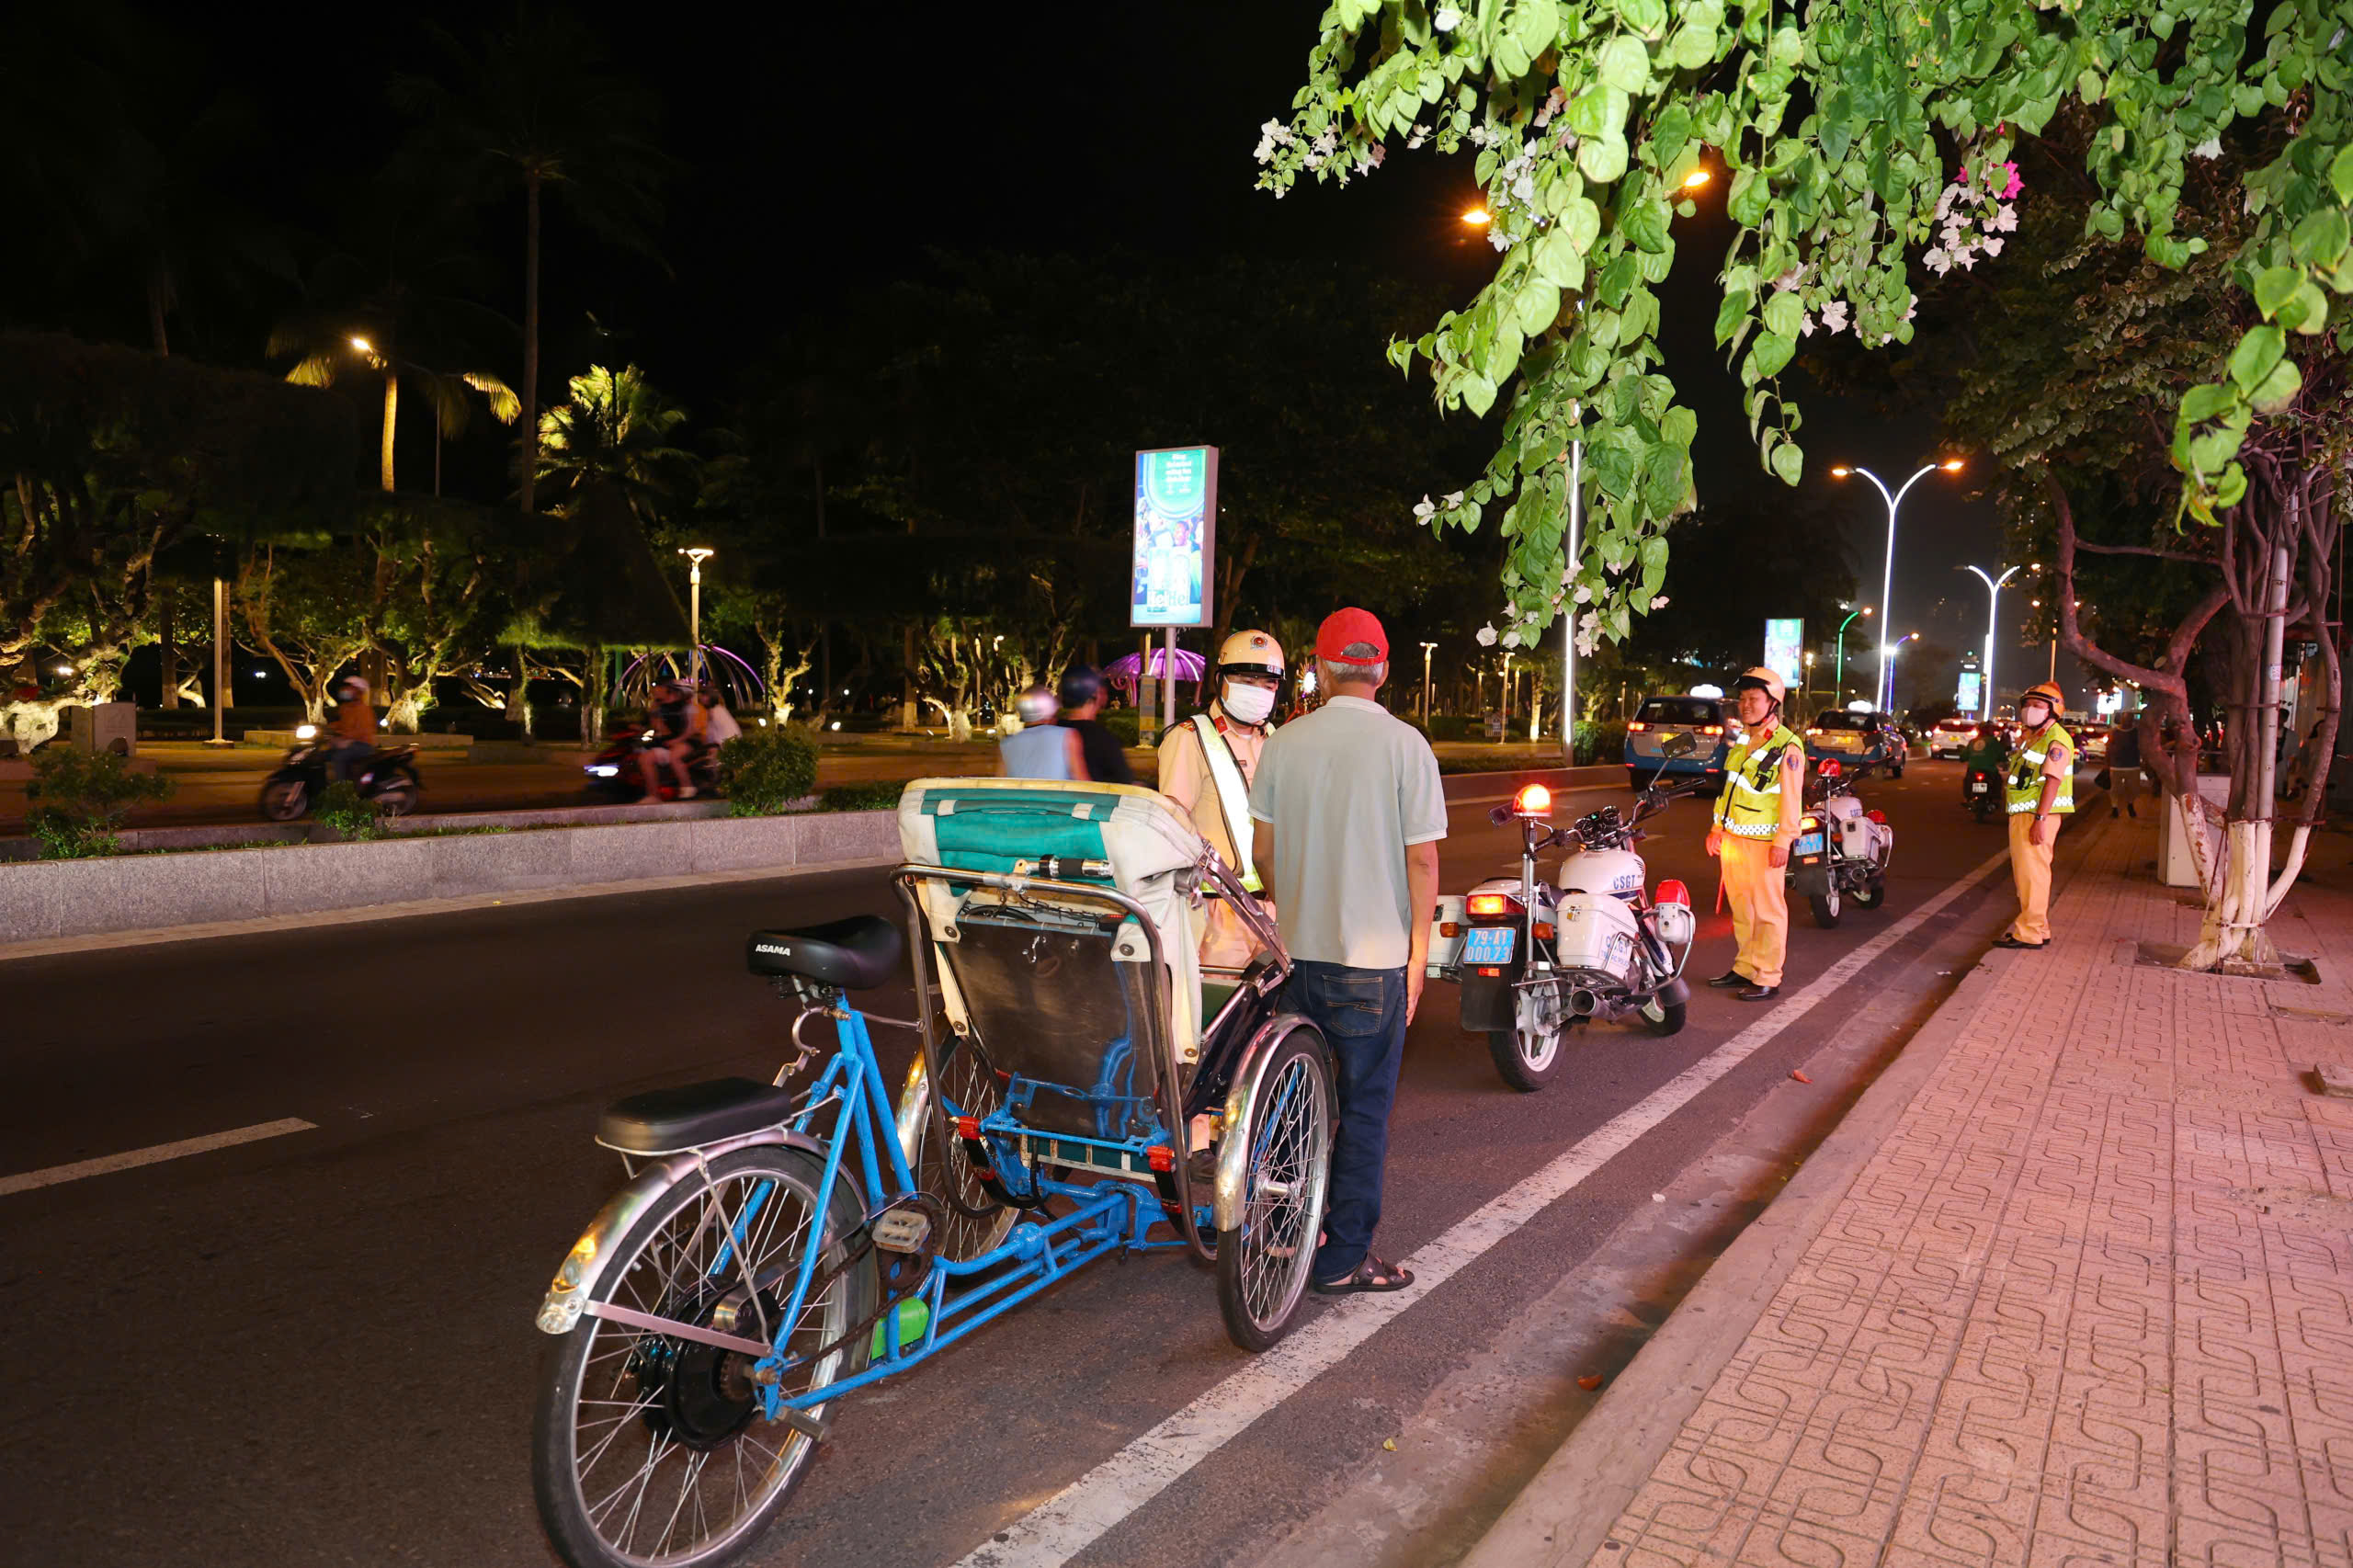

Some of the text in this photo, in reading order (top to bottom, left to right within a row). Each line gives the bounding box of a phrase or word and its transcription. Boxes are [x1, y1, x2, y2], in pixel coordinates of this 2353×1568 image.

[1613, 875, 1635, 890] CSGT
[756, 944, 790, 956] ASAMA
[1466, 946, 1509, 961] 000.73
